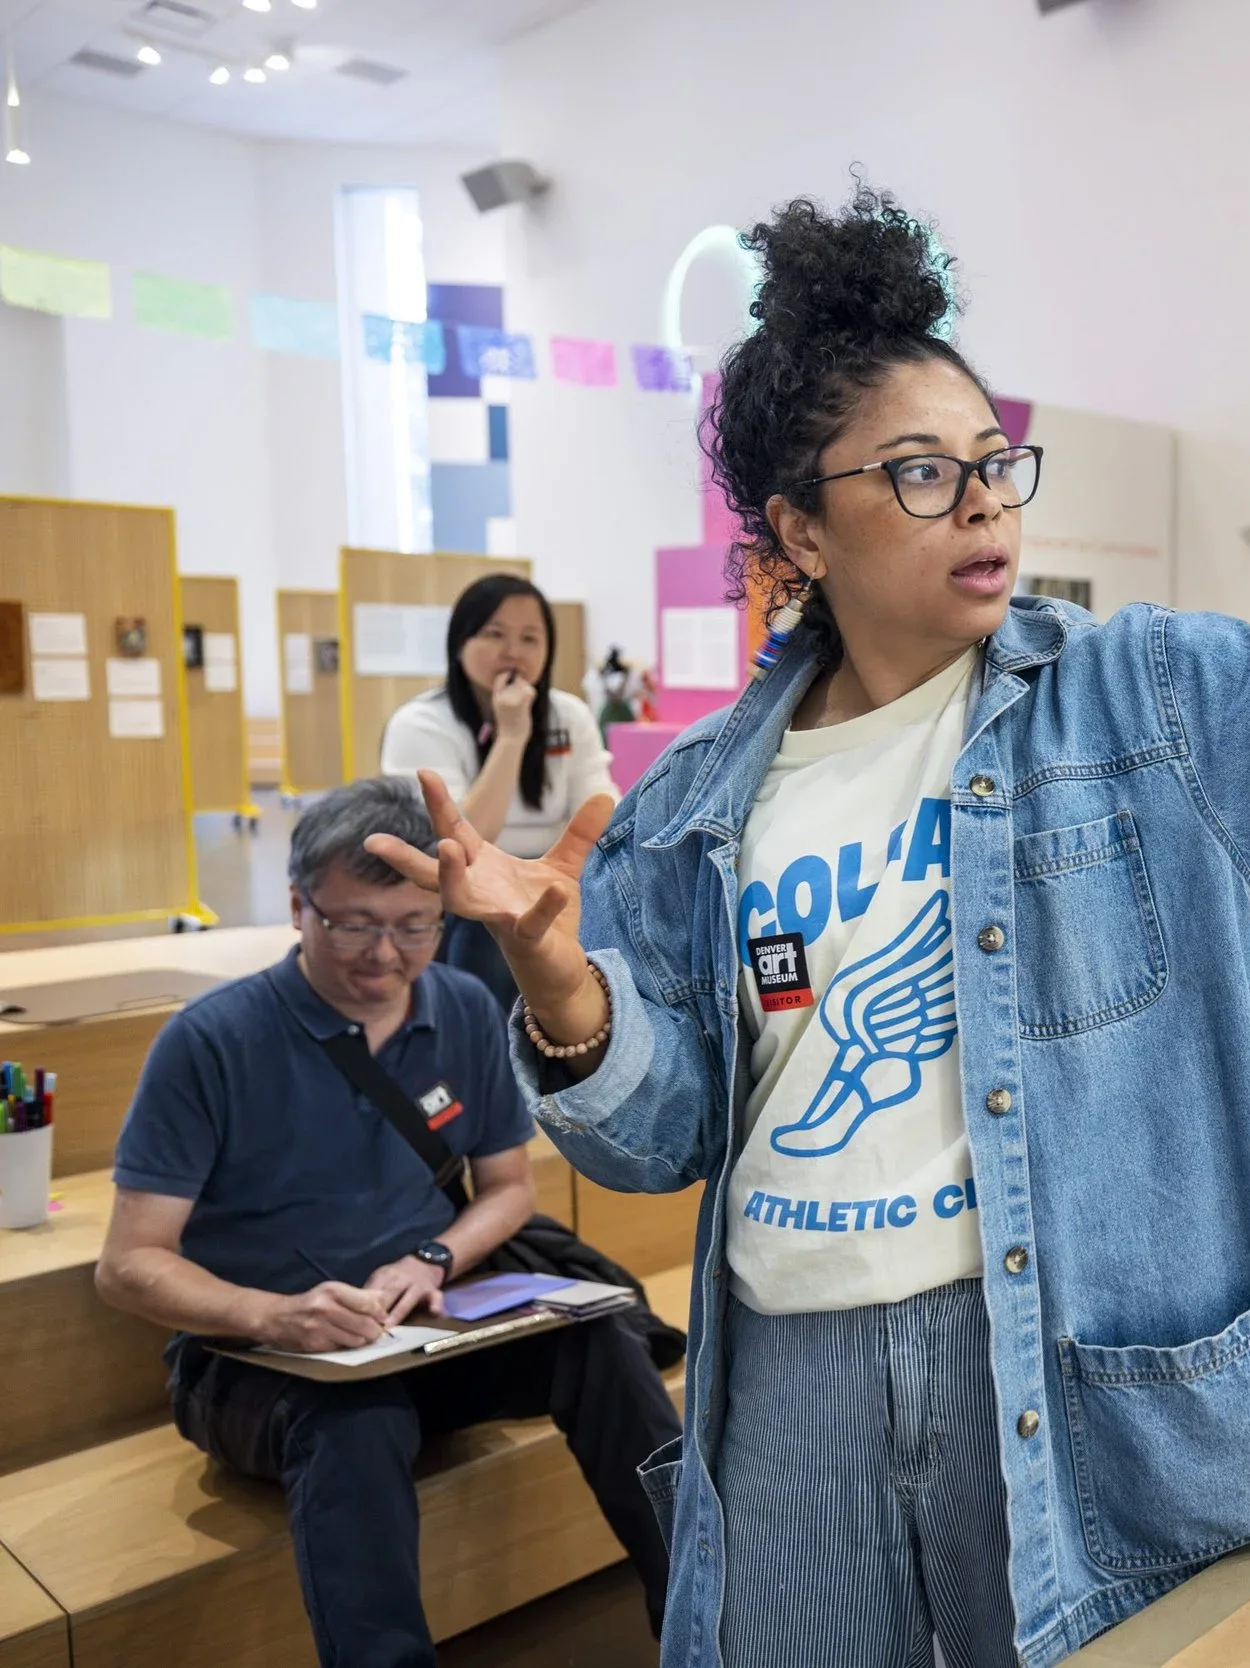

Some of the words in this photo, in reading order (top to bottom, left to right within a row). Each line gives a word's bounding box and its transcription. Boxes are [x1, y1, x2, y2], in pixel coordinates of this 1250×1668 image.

[756, 943, 787, 956] DENVER
[758, 942, 797, 976] art
[761, 972, 798, 986] MUSEUM
[743, 1190, 918, 1233] ATHLETIC
